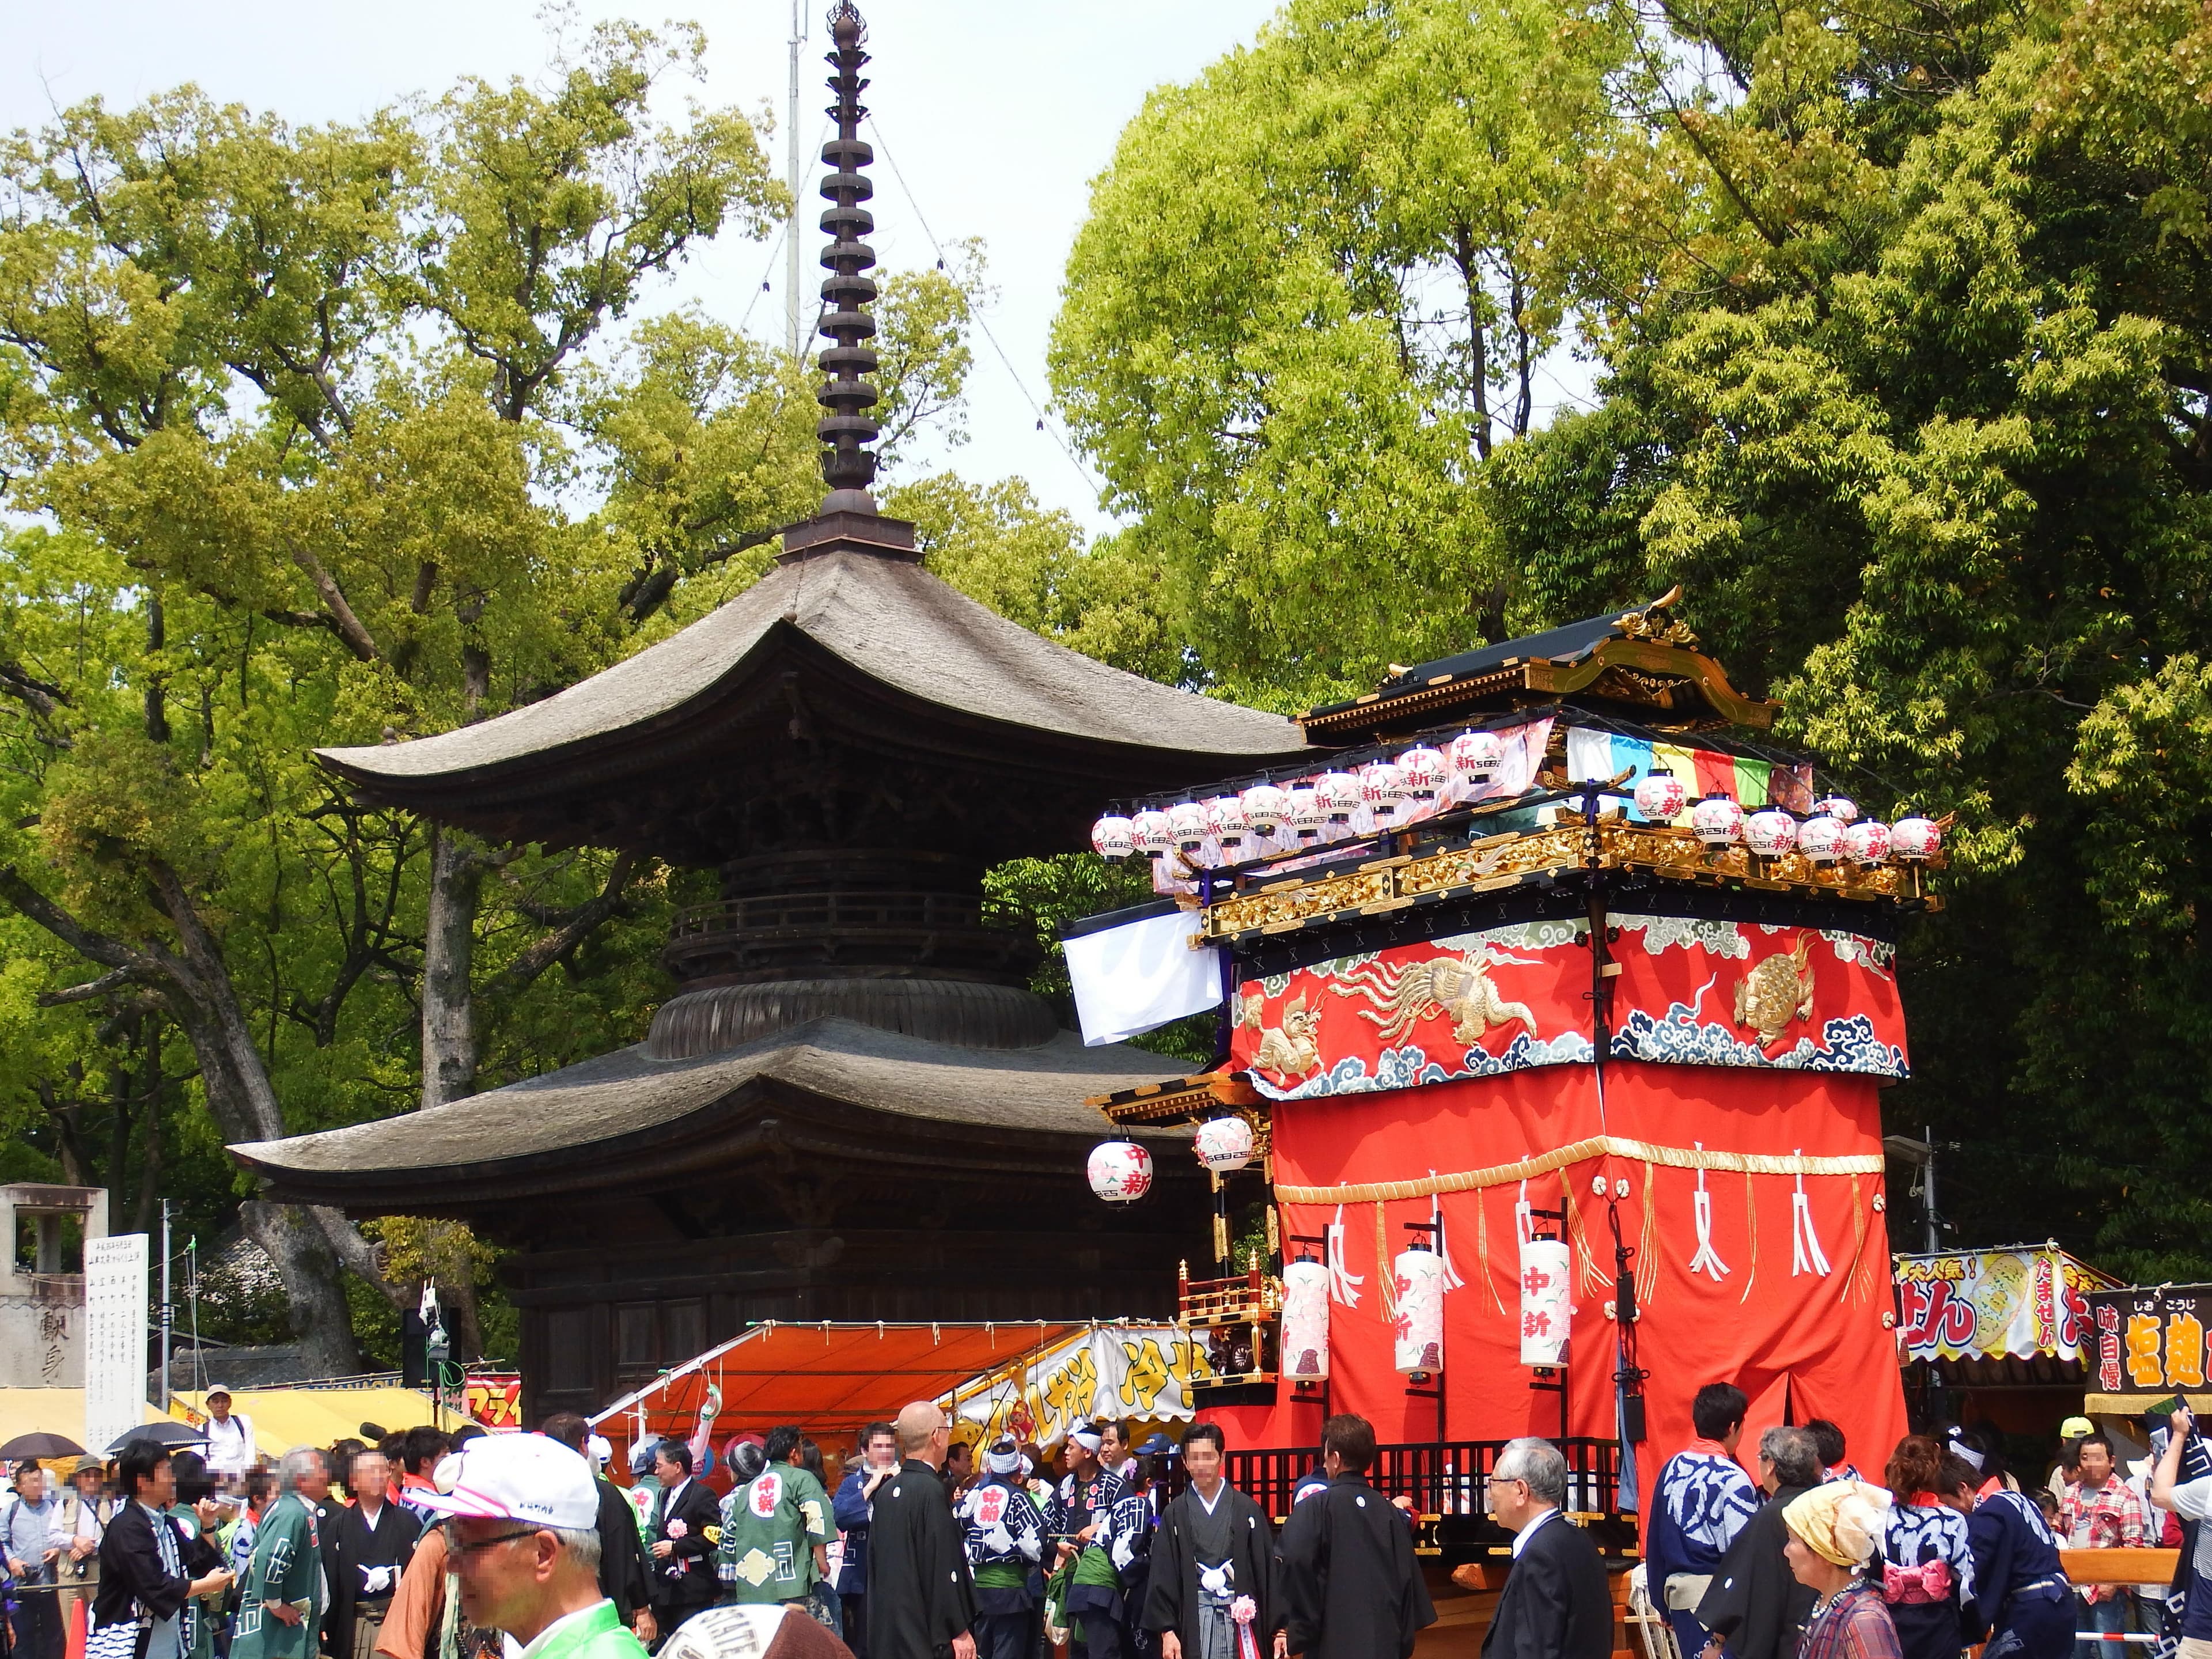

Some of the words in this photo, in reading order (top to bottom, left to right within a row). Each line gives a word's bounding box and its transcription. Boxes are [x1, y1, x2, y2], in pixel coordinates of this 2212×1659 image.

[1407, 752, 1430, 787] 中新
[1456, 738, 1475, 770] 中新
[1315, 778, 1332, 812] 中新
[1361, 768, 1382, 802] 中新
[1660, 780, 1683, 815] 中新
[1772, 815, 1793, 850] 中新
[1831, 820, 1848, 855] 中新
[1865, 825, 1889, 858] 中新
[1923, 824, 1940, 853] 中新
[1121, 1145, 1151, 1196] 中新
[1524, 1266, 1551, 1338] 中新
[2036, 1256, 2054, 1348] たません
[2134, 1301, 2154, 1311] しお
[2166, 1298, 2196, 1311] こうじ
[2097, 1304, 2121, 1391] 味自慢
[2125, 1312, 2212, 1387] 塩麹
[757, 1476, 776, 1513] 中新
[979, 1488, 1003, 1522] 中新
